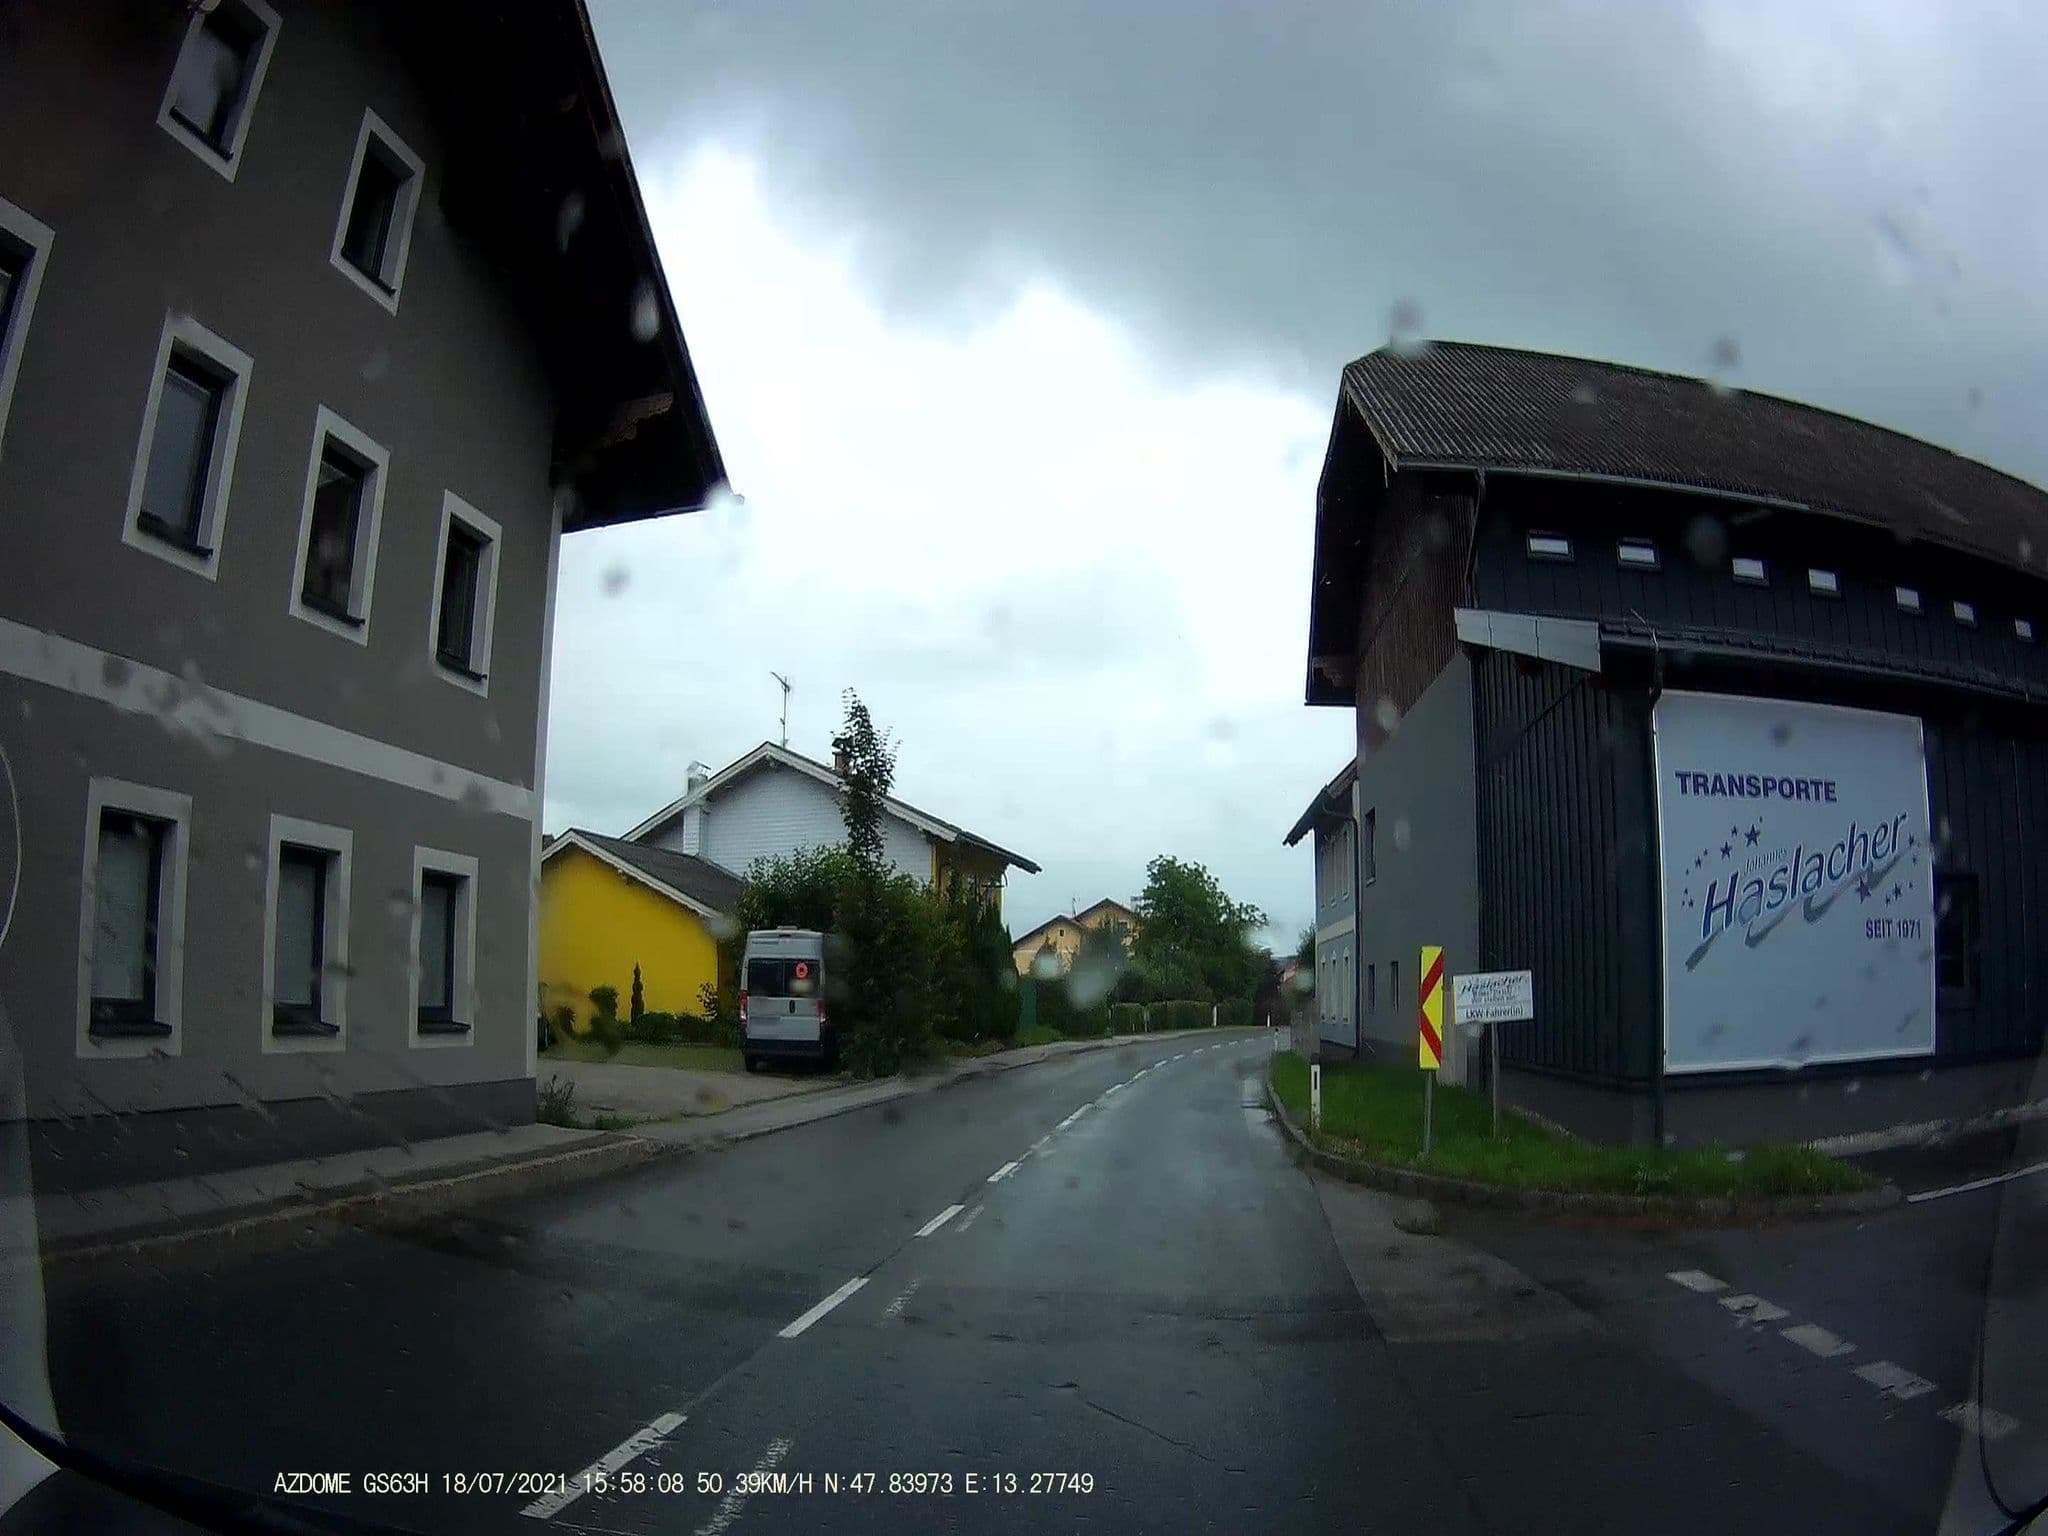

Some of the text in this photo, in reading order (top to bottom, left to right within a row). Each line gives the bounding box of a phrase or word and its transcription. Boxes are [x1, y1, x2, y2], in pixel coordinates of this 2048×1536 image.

[1675, 771, 1837, 803] TRANSPORTE
[1701, 811, 1907, 939] Haslacher
[1865, 919, 1893, 939] SEIT
